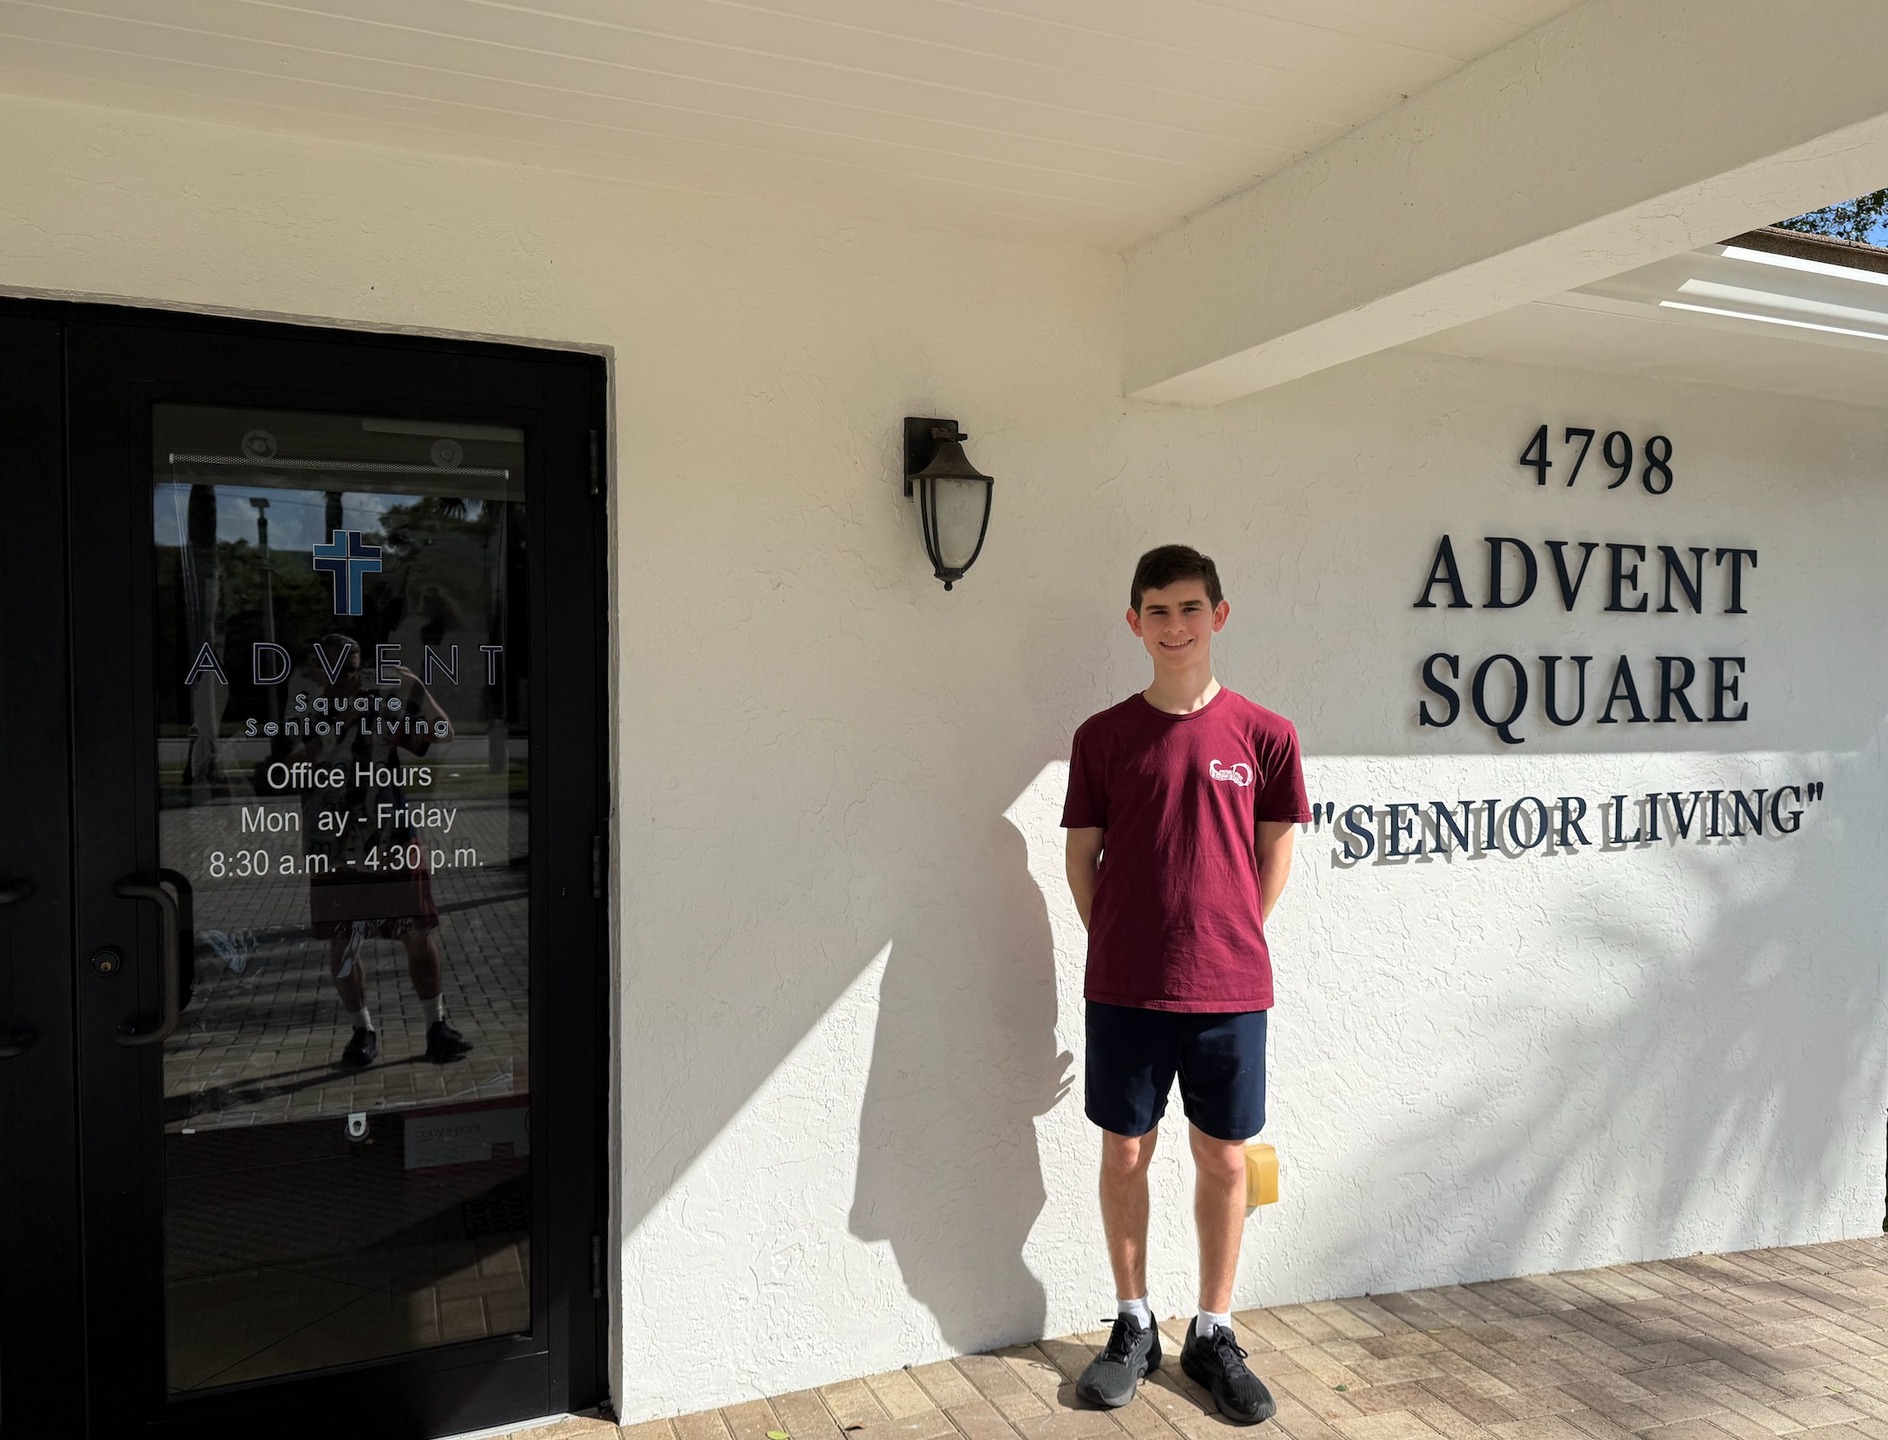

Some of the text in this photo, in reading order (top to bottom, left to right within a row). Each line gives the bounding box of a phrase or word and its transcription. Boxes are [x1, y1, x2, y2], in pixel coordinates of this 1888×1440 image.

[1519, 424, 1674, 495] 4798
[1413, 534, 1758, 614] ADVENT
[185, 642, 503, 686] ADVENT
[295, 694, 402, 715] Square
[1419, 652, 1749, 745] SQUARE
[245, 717, 450, 739] Senior Living
[267, 762, 433, 789] Office Hours
[377, 803, 458, 833] Friday
[209, 850, 269, 878] 8:30
[279, 853, 337, 875] a.m.
[364, 845, 421, 871] 4:30
[430, 847, 485, 875] p.m.
